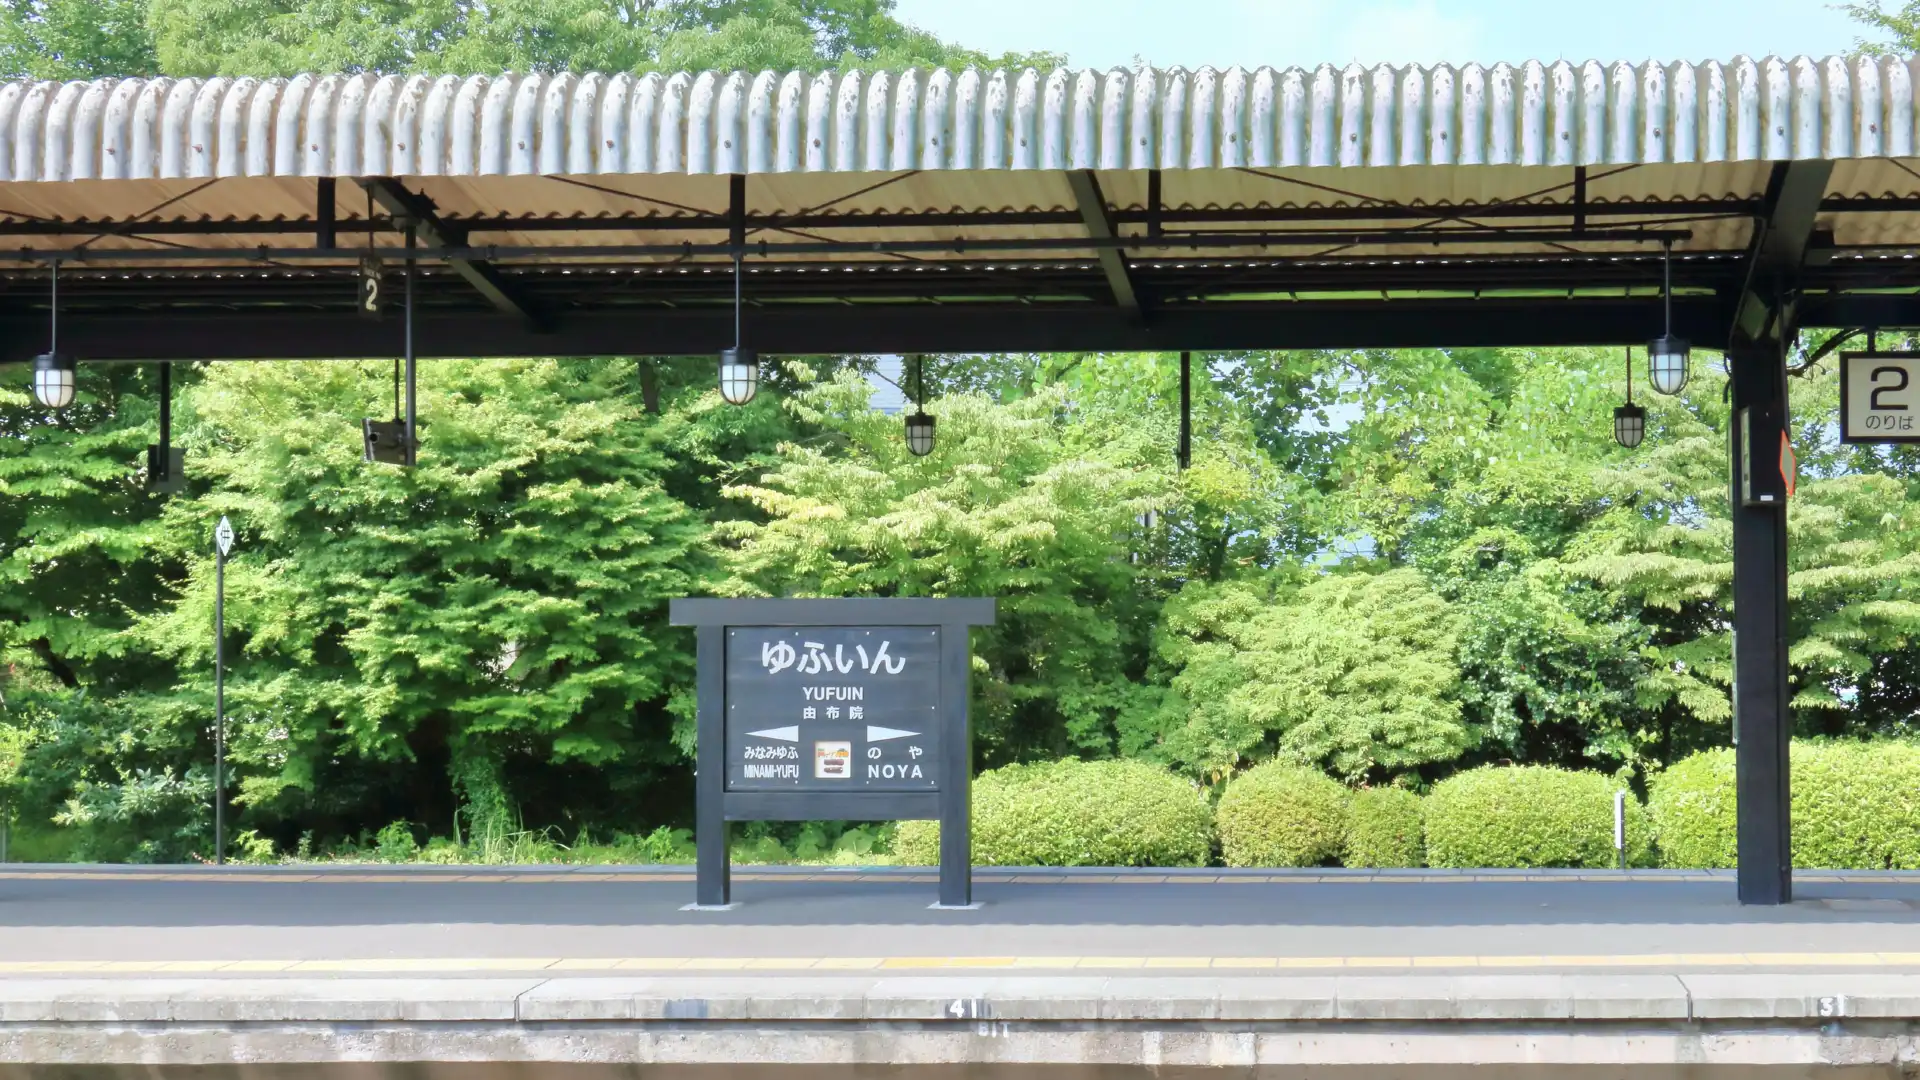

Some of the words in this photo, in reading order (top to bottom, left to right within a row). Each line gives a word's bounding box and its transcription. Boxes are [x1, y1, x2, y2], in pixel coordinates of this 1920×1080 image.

[365, 278, 378, 312] 2
[1870, 366, 1909, 410] 2
[1865, 415, 1914, 430] のりば
[762, 640, 906, 675] ゆふいん
[803, 686, 864, 701] YUFUIN
[803, 706, 864, 720] 由布院
[744, 746, 799, 760] みなみゆふ
[744, 764, 799, 779] MINAMI-YUFU
[867, 764, 923, 779] NOYA
